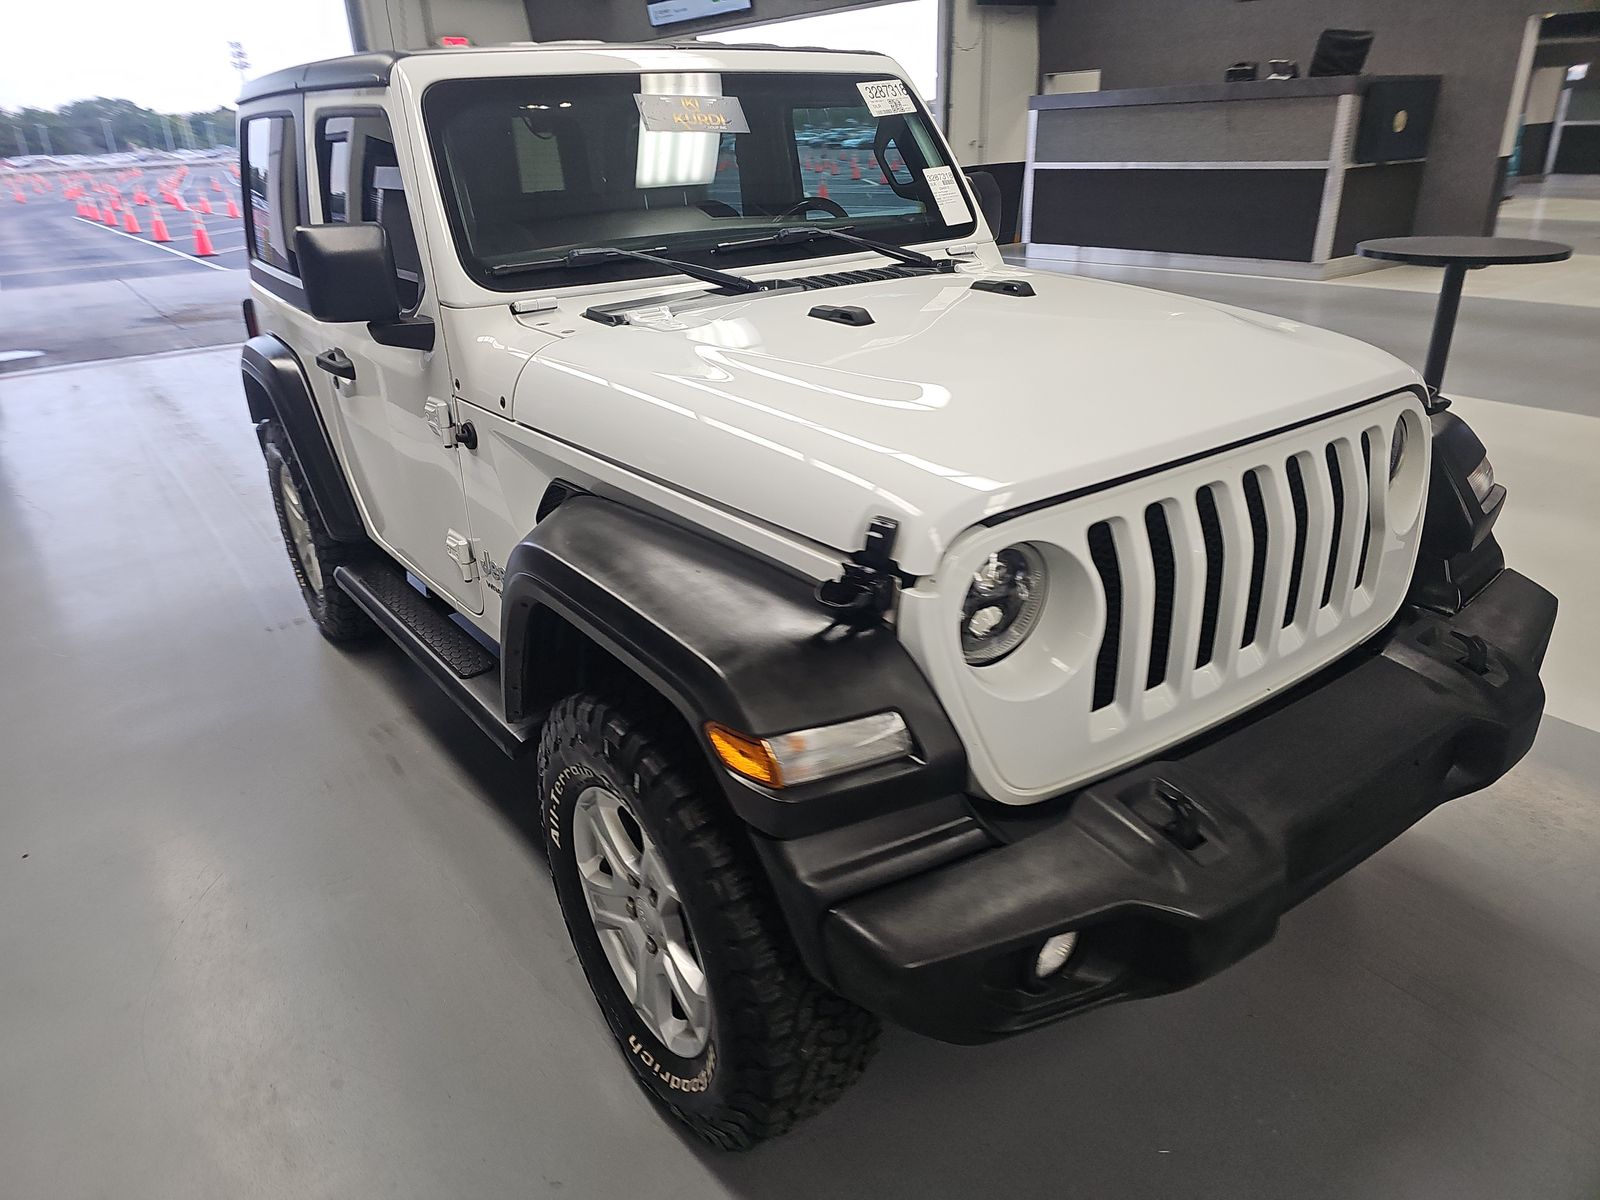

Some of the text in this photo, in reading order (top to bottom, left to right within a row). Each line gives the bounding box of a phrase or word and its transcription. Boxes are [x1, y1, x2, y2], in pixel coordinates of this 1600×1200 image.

[865, 83, 908, 99] 3287318
[480, 549, 507, 582] Jee
[549, 763, 594, 849] All-Terrain
